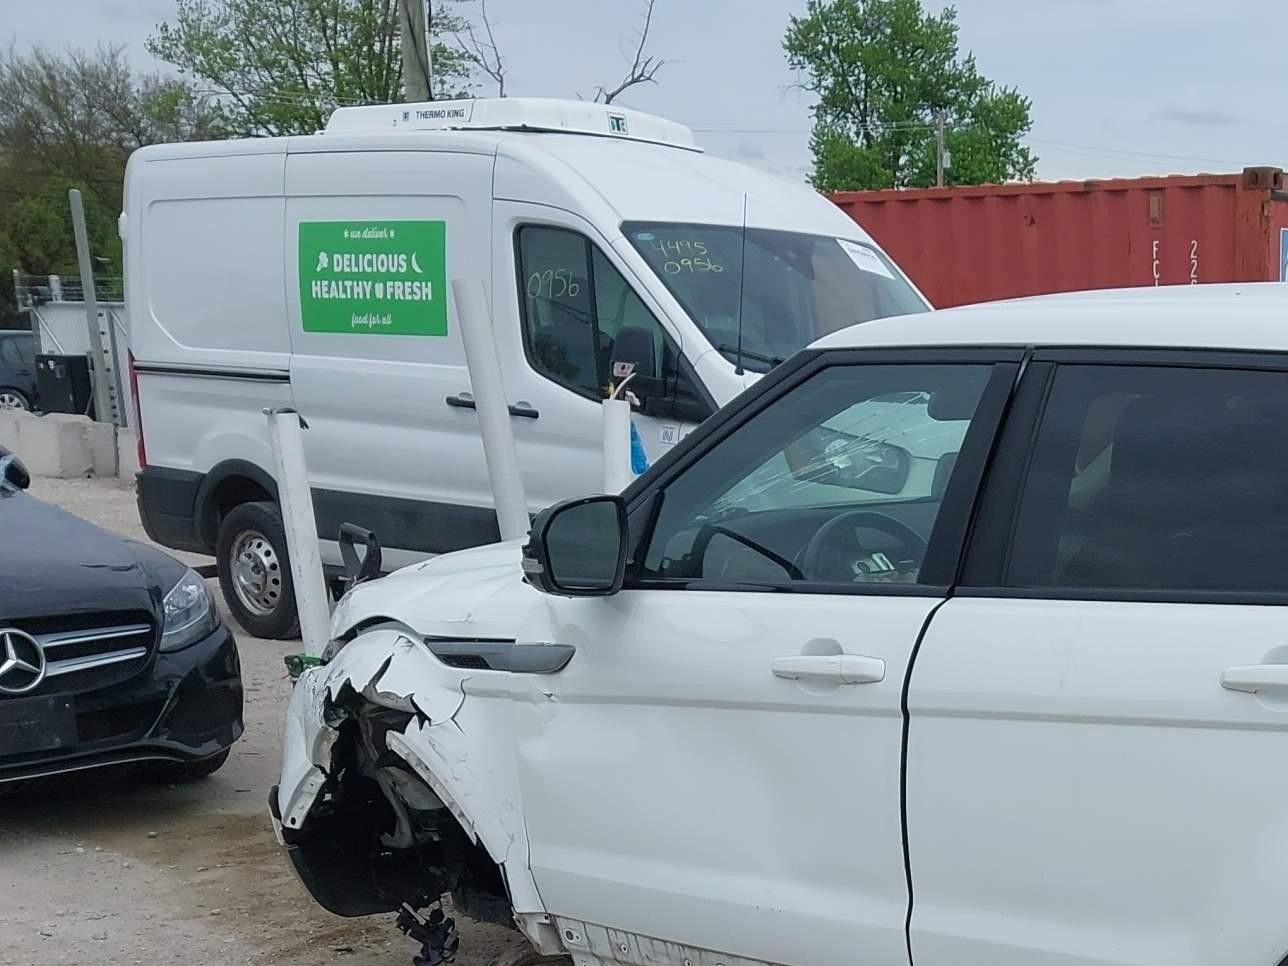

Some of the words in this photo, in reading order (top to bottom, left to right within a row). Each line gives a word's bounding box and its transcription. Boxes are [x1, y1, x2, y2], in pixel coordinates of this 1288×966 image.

[416, 110, 445, 120] THERMO
[447, 109, 464, 118] KING
[350, 229, 361, 238] we
[362, 226, 388, 239] deliver
[333, 253, 407, 273] DELICIOUS
[664, 257, 724, 274] 0956
[311, 279, 372, 299] HEALTHY
[386, 281, 432, 301] FRESH
[527, 269, 579, 298] 0956
[352, 311, 369, 328] food
[369, 312, 381, 328] for
[382, 313, 392, 325] all
